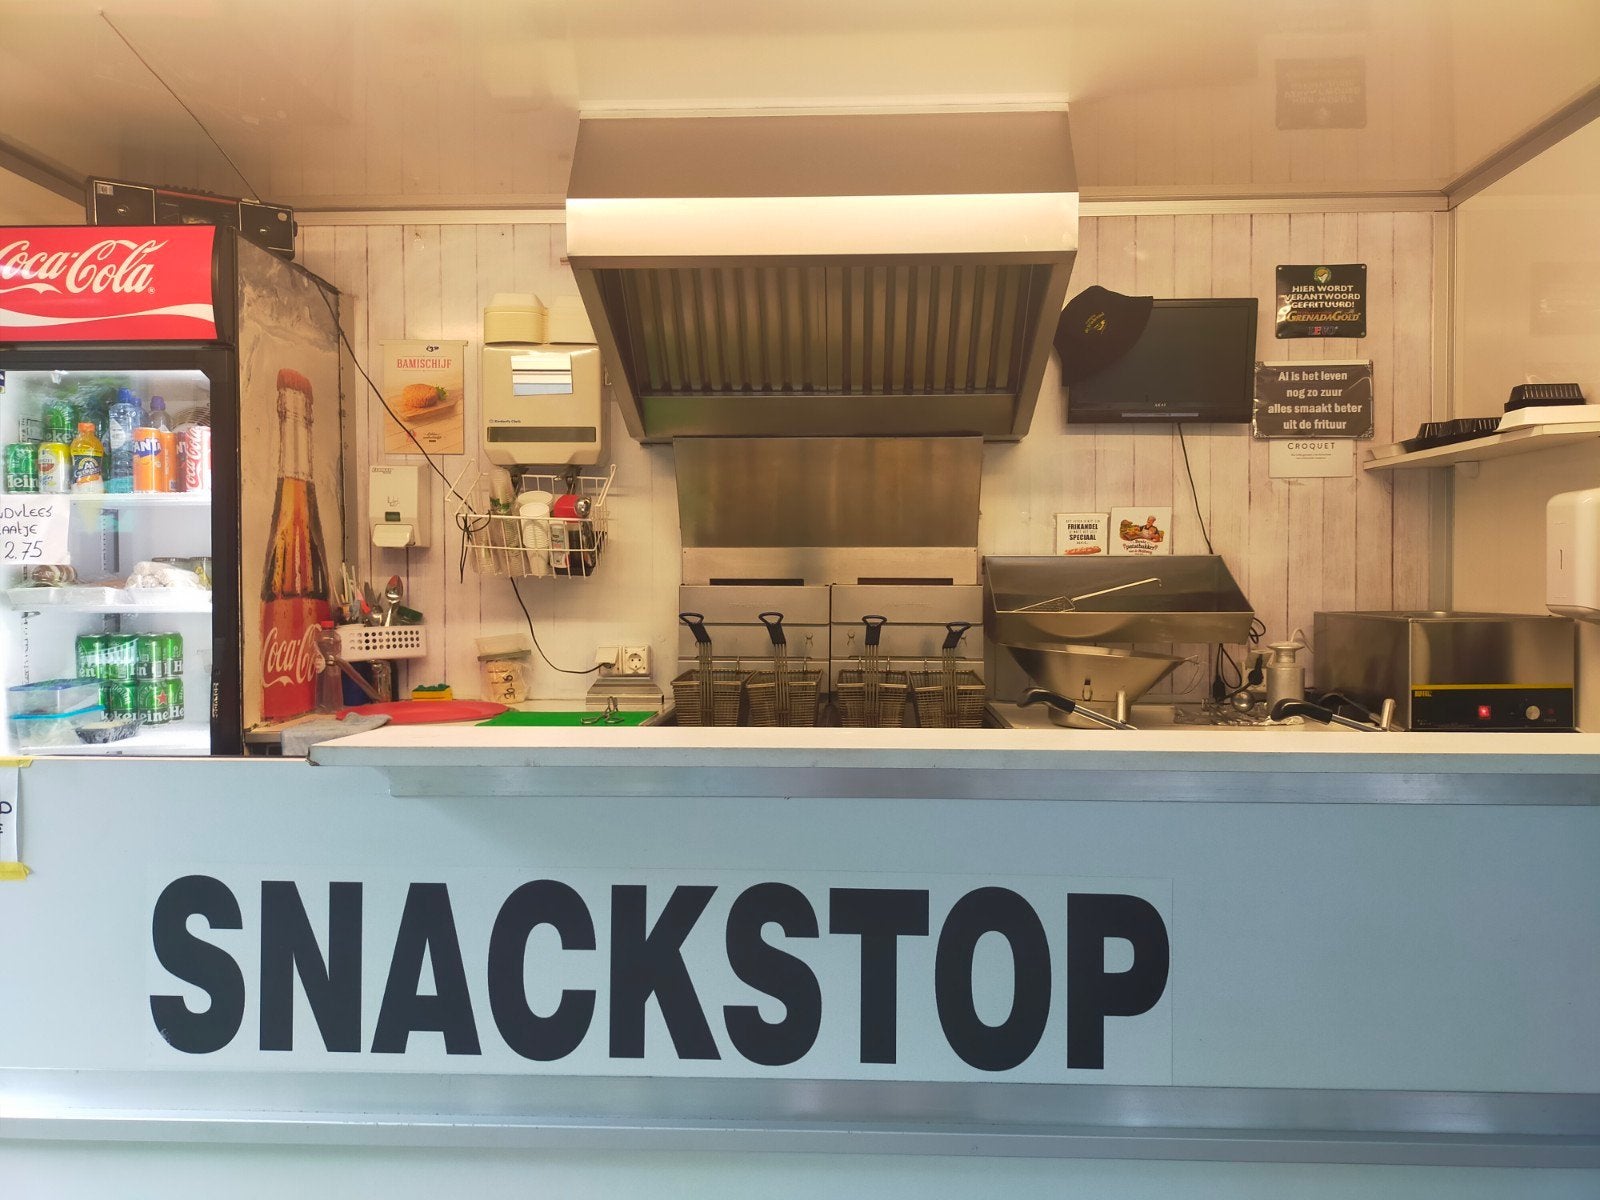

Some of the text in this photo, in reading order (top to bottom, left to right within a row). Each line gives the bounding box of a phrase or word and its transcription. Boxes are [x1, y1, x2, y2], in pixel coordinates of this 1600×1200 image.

[397, 358, 452, 369] BAMISCHIJF
[1278, 371, 1348, 381] Al is het leven
[1286, 389, 1343, 399] nog zo zuur
[1268, 403, 1362, 413] alles smaakt beter
[1283, 419, 1347, 429] uit de frituur
[1287, 442, 1336, 451] CROQUET
[4, 540, 43, 560] 2.75
[150, 874, 1170, 1072] SNACKSTOP
